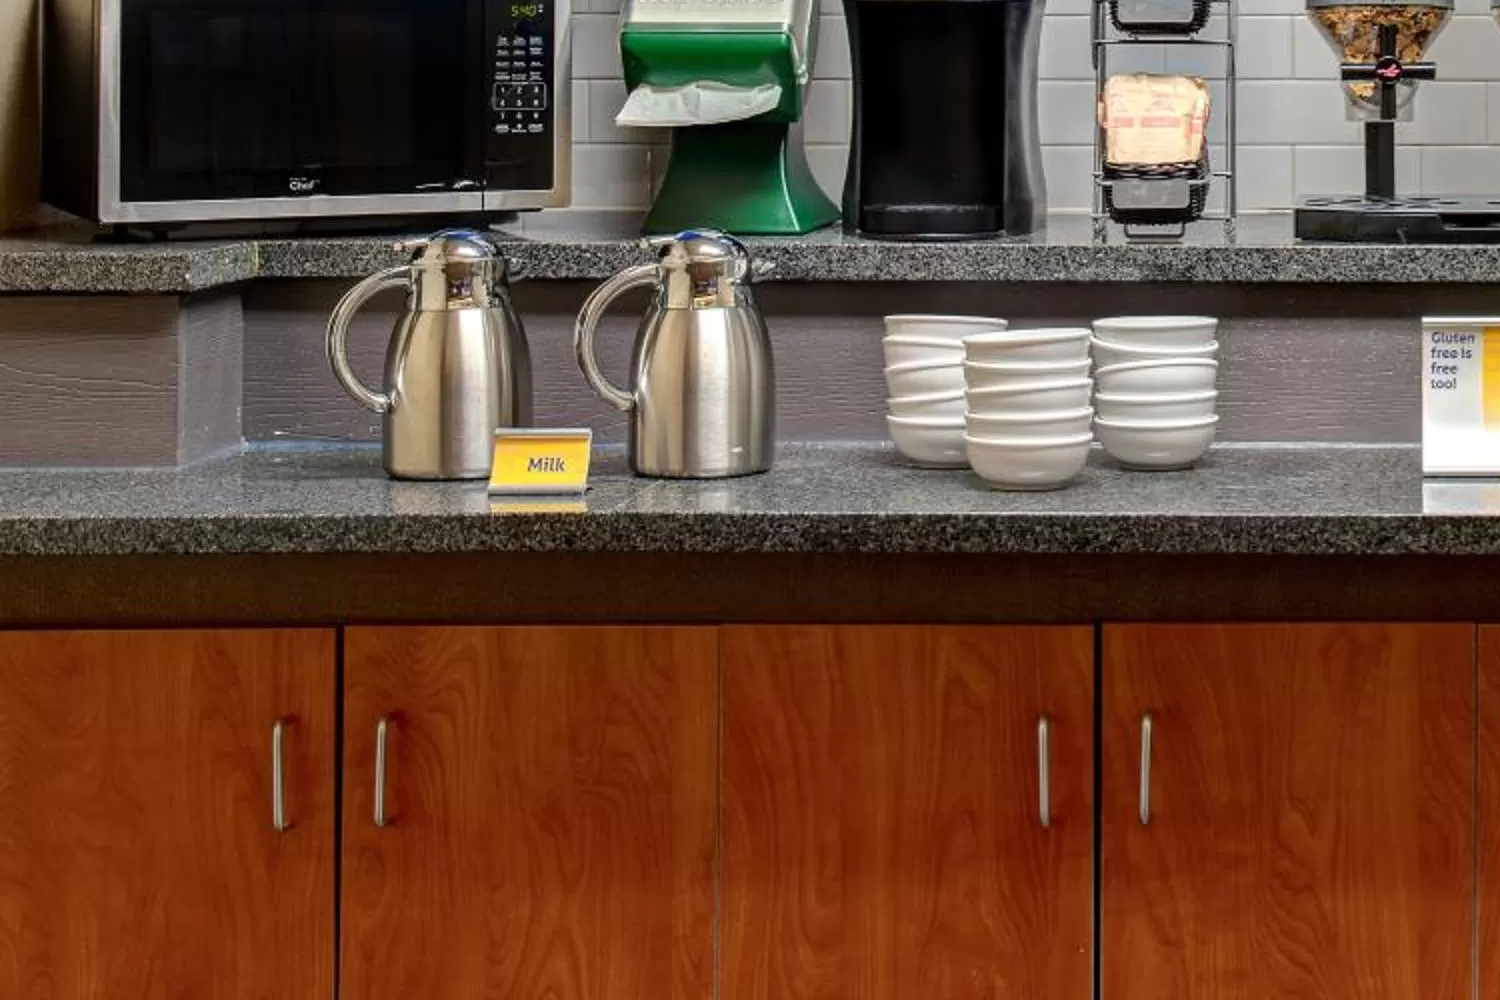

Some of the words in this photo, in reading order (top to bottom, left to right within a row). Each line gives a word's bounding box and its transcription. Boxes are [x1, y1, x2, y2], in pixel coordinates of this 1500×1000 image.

[1431, 331, 1475, 344] Gluten
[1431, 345, 1458, 359] free
[1431, 361, 1457, 375] free
[1431, 378, 1457, 389] too!
[528, 456, 565, 472] Milk
